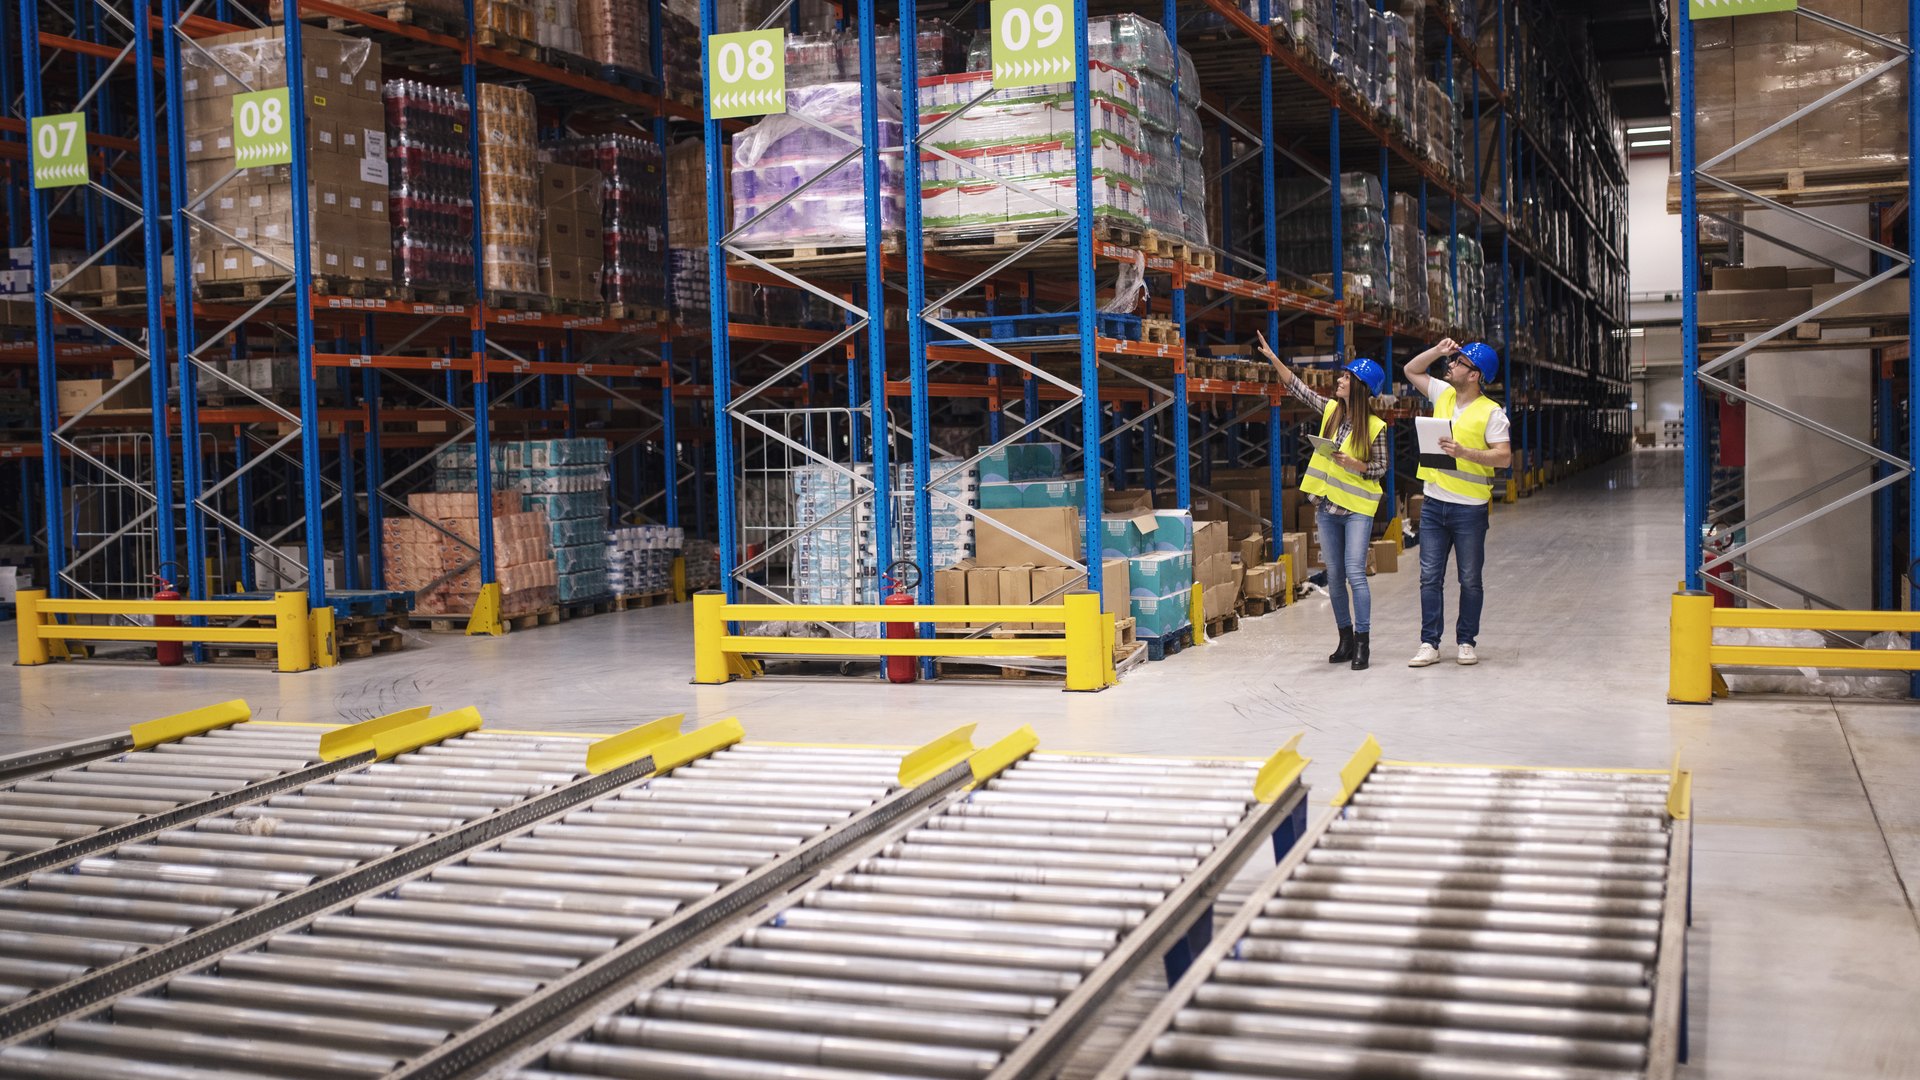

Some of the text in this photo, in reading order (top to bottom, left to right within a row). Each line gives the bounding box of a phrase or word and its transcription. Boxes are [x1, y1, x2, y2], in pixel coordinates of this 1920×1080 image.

[1001, 3, 1064, 51] 09
[717, 39, 775, 84] 08
[239, 97, 283, 138] 08
[37, 121, 78, 159] 07
